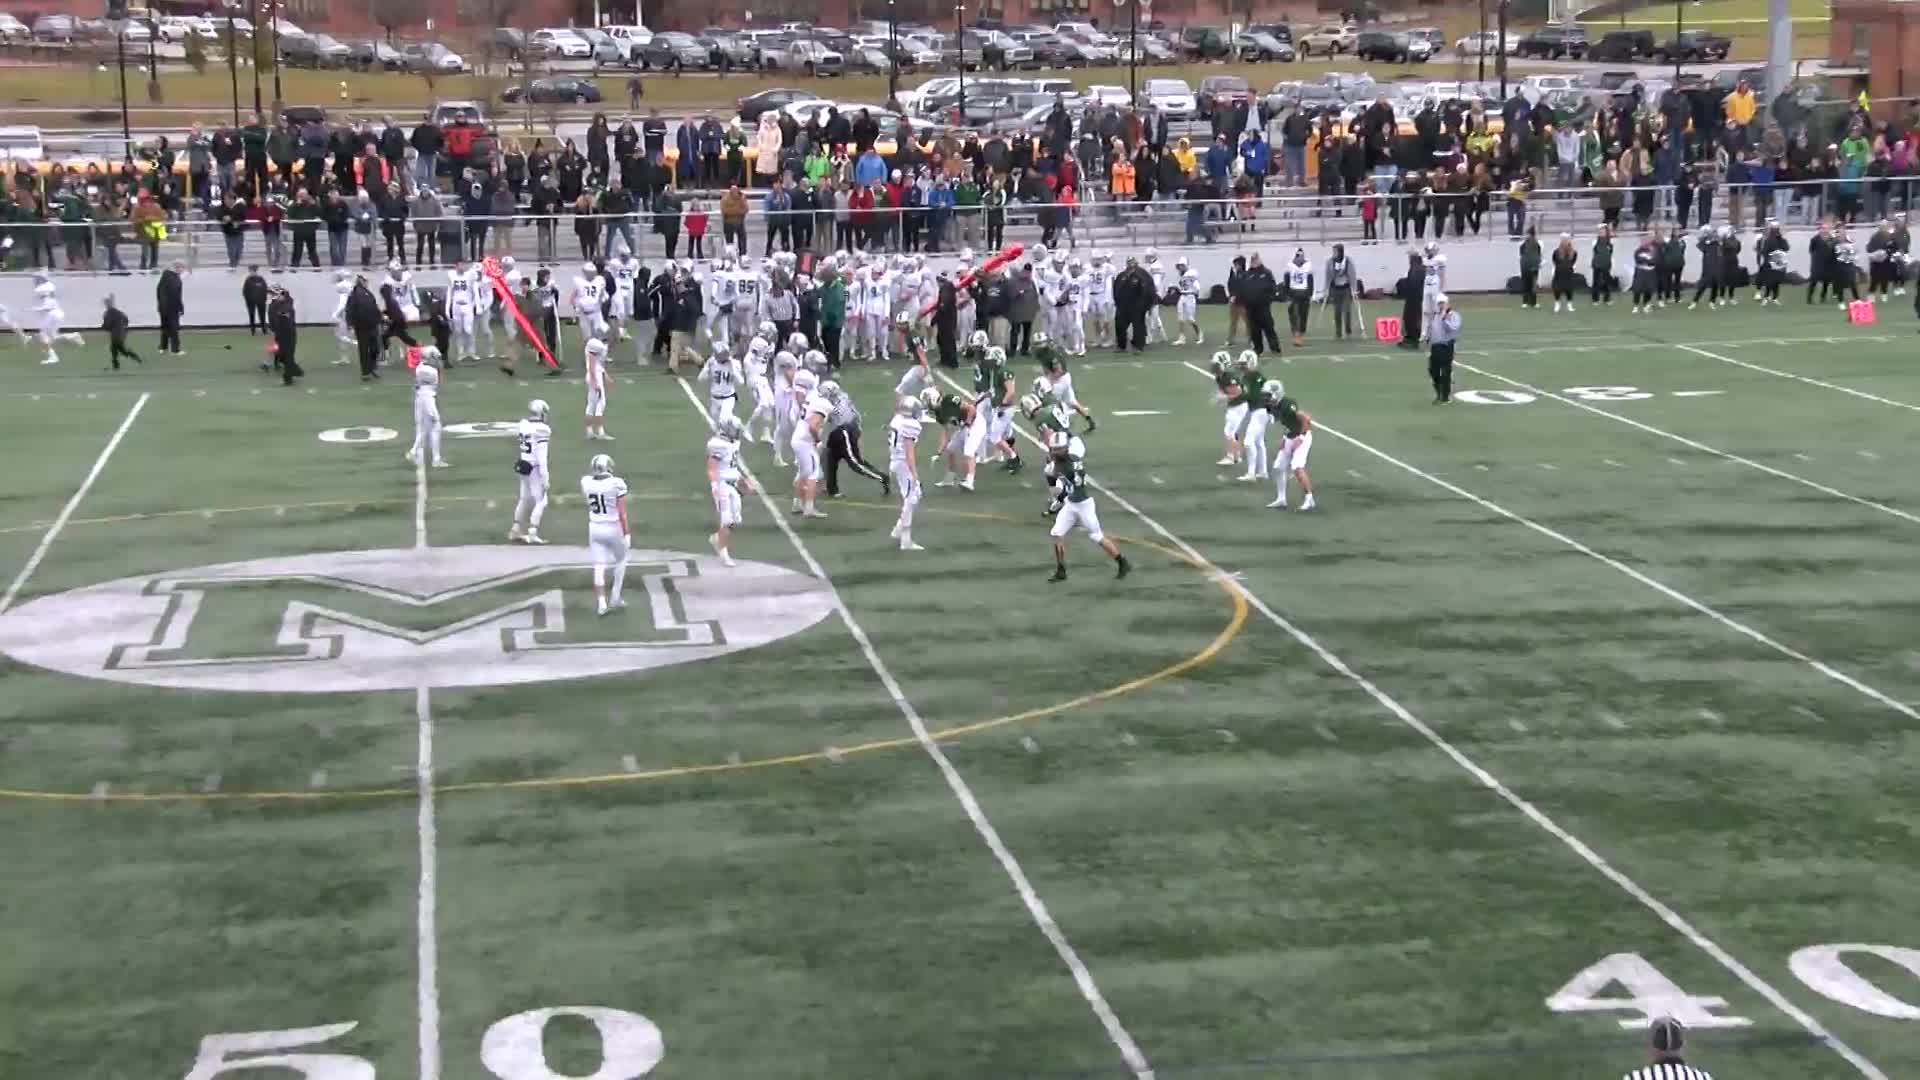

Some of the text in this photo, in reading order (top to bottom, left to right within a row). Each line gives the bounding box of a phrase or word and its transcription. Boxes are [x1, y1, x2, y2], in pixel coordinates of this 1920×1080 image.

[739, 279, 755, 295] 85
[1380, 320, 1398, 339] 30
[588, 493, 607, 514] 31
[104, 558, 727, 670] M
